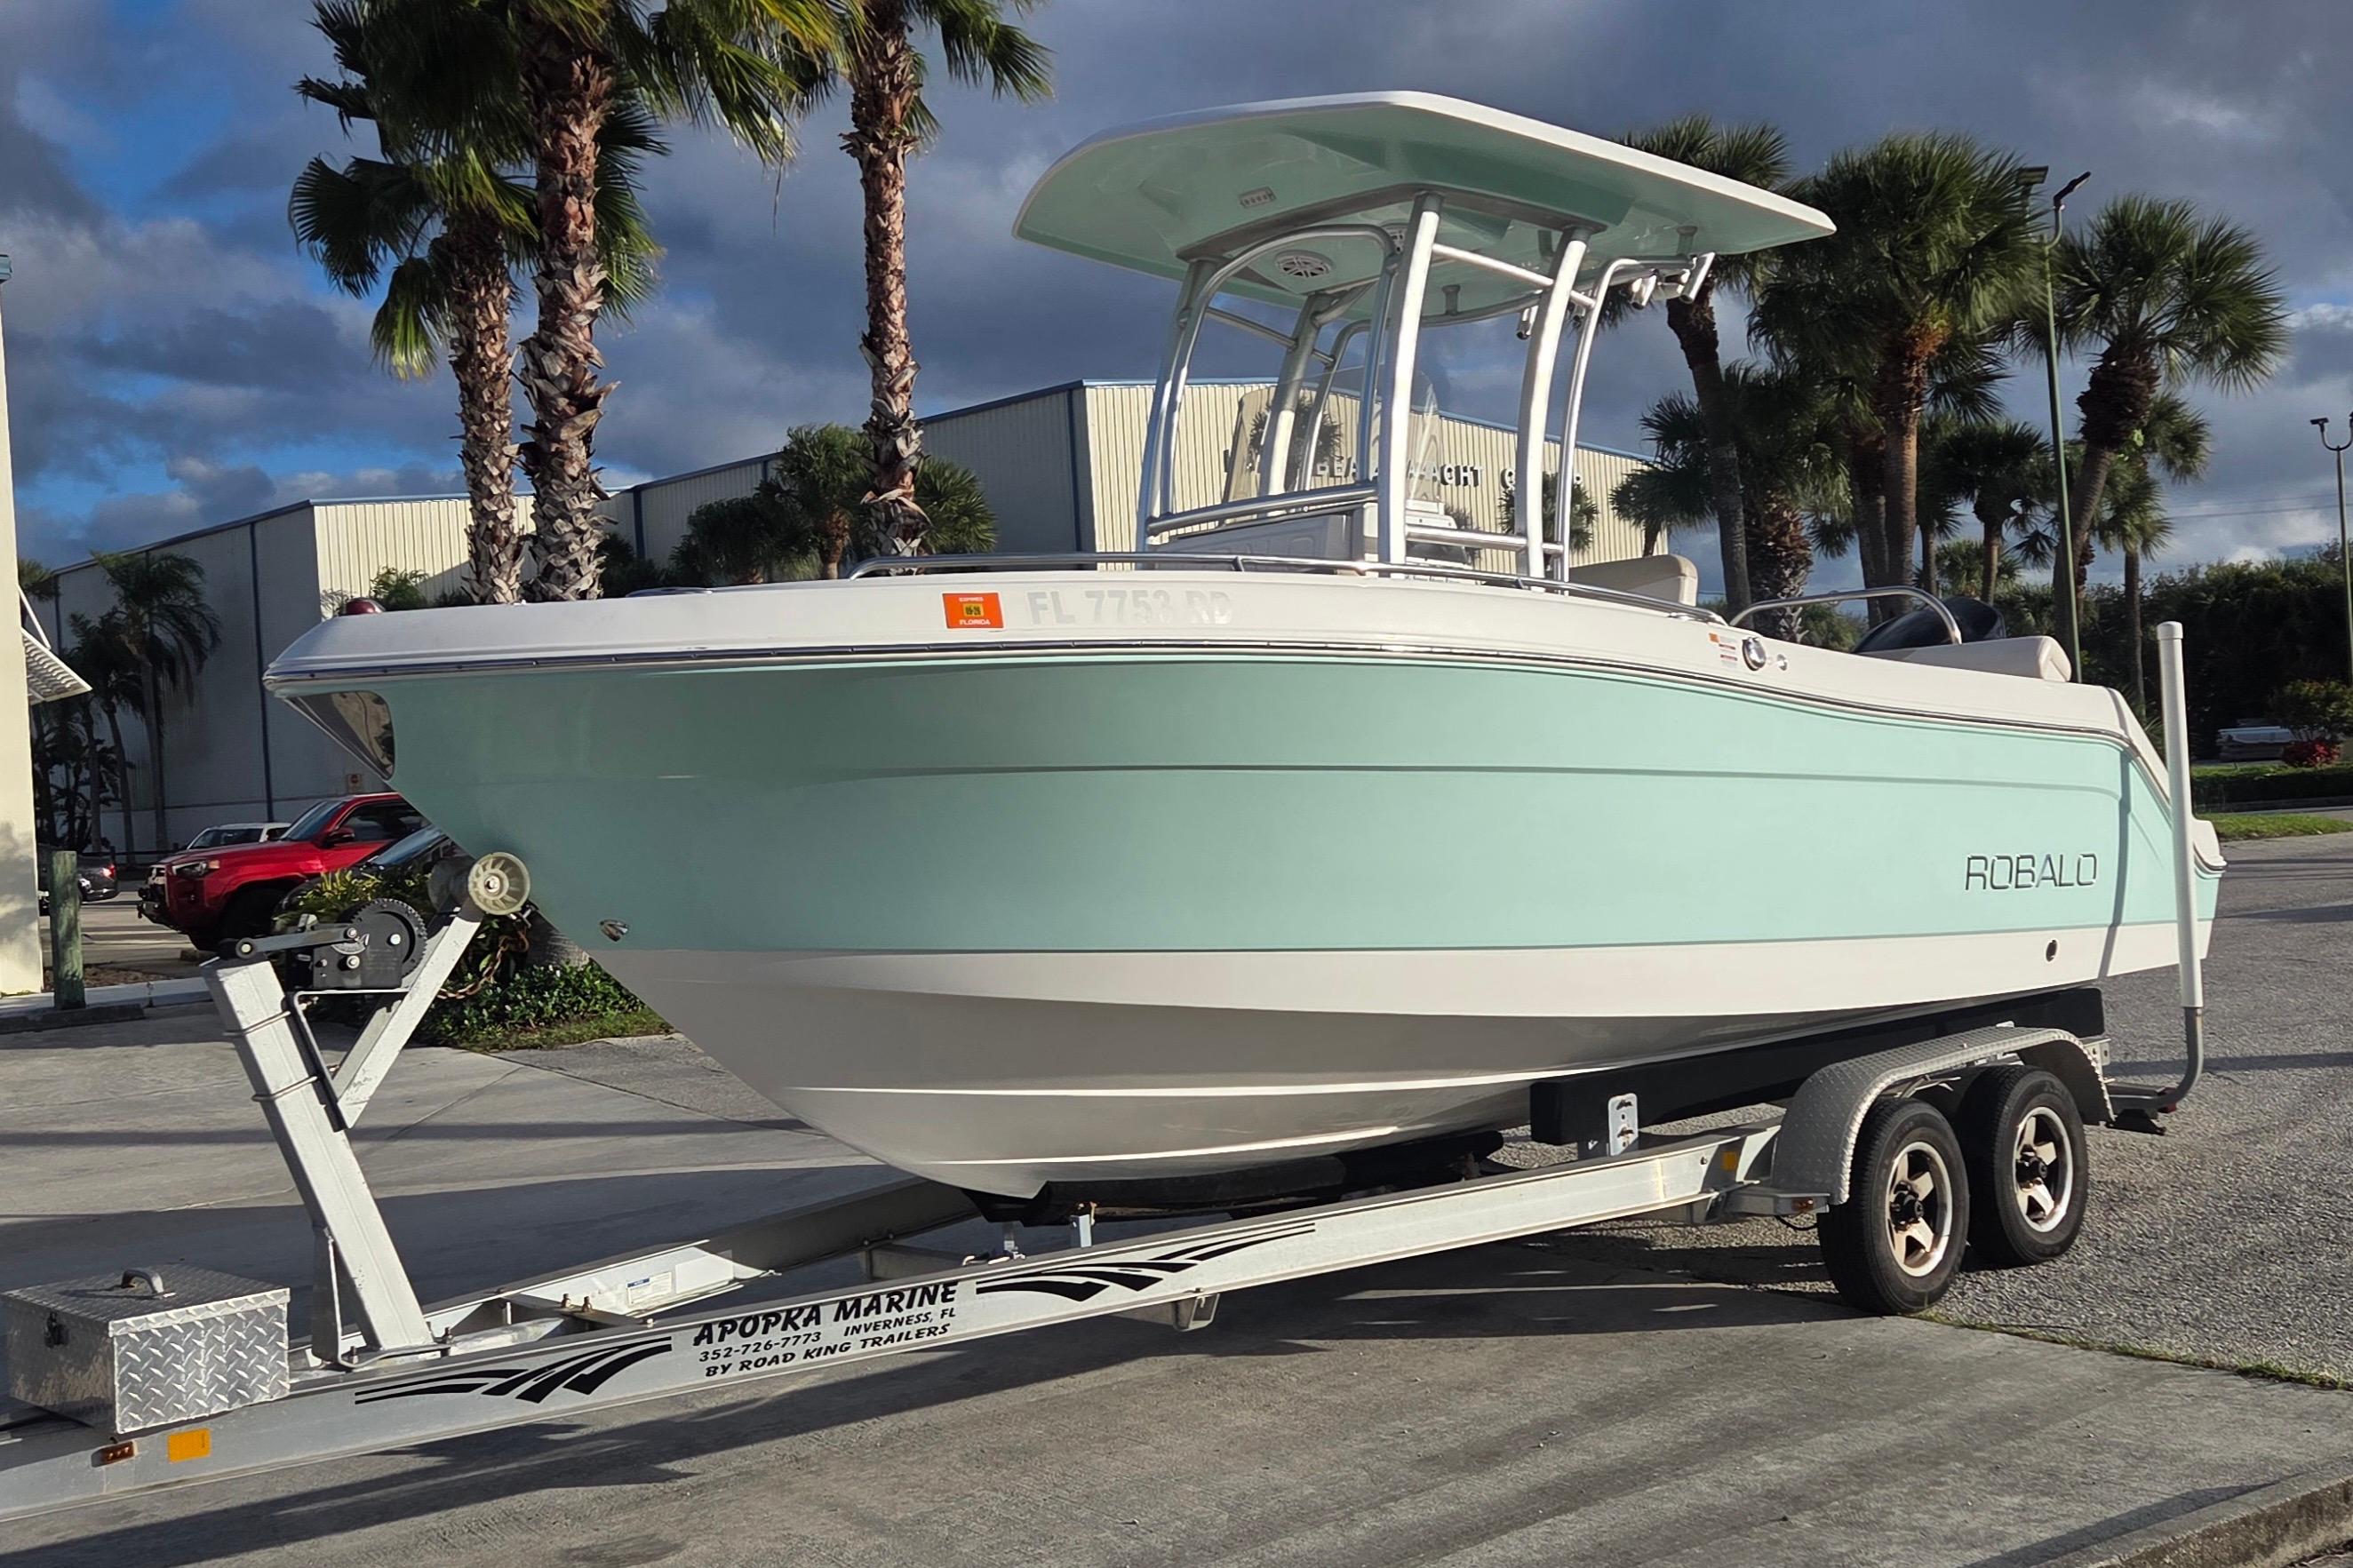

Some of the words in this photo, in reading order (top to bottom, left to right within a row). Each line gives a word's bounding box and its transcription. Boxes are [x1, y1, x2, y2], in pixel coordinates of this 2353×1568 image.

[1026, 591, 1075, 625] FL
[1965, 853, 2097, 890] ROBALO
[693, 1304, 821, 1346] APOPKA
[834, 1281, 959, 1322] MARINE
[698, 1332, 822, 1363] 352-726-7773
[843, 1311, 933, 1337] INVERNESS,
[940, 1307, 956, 1319] FL
[706, 1363, 732, 1377] BY
[739, 1352, 796, 1372] ROAD
[802, 1341, 852, 1360] KING
[860, 1323, 951, 1349] TRAILERS
